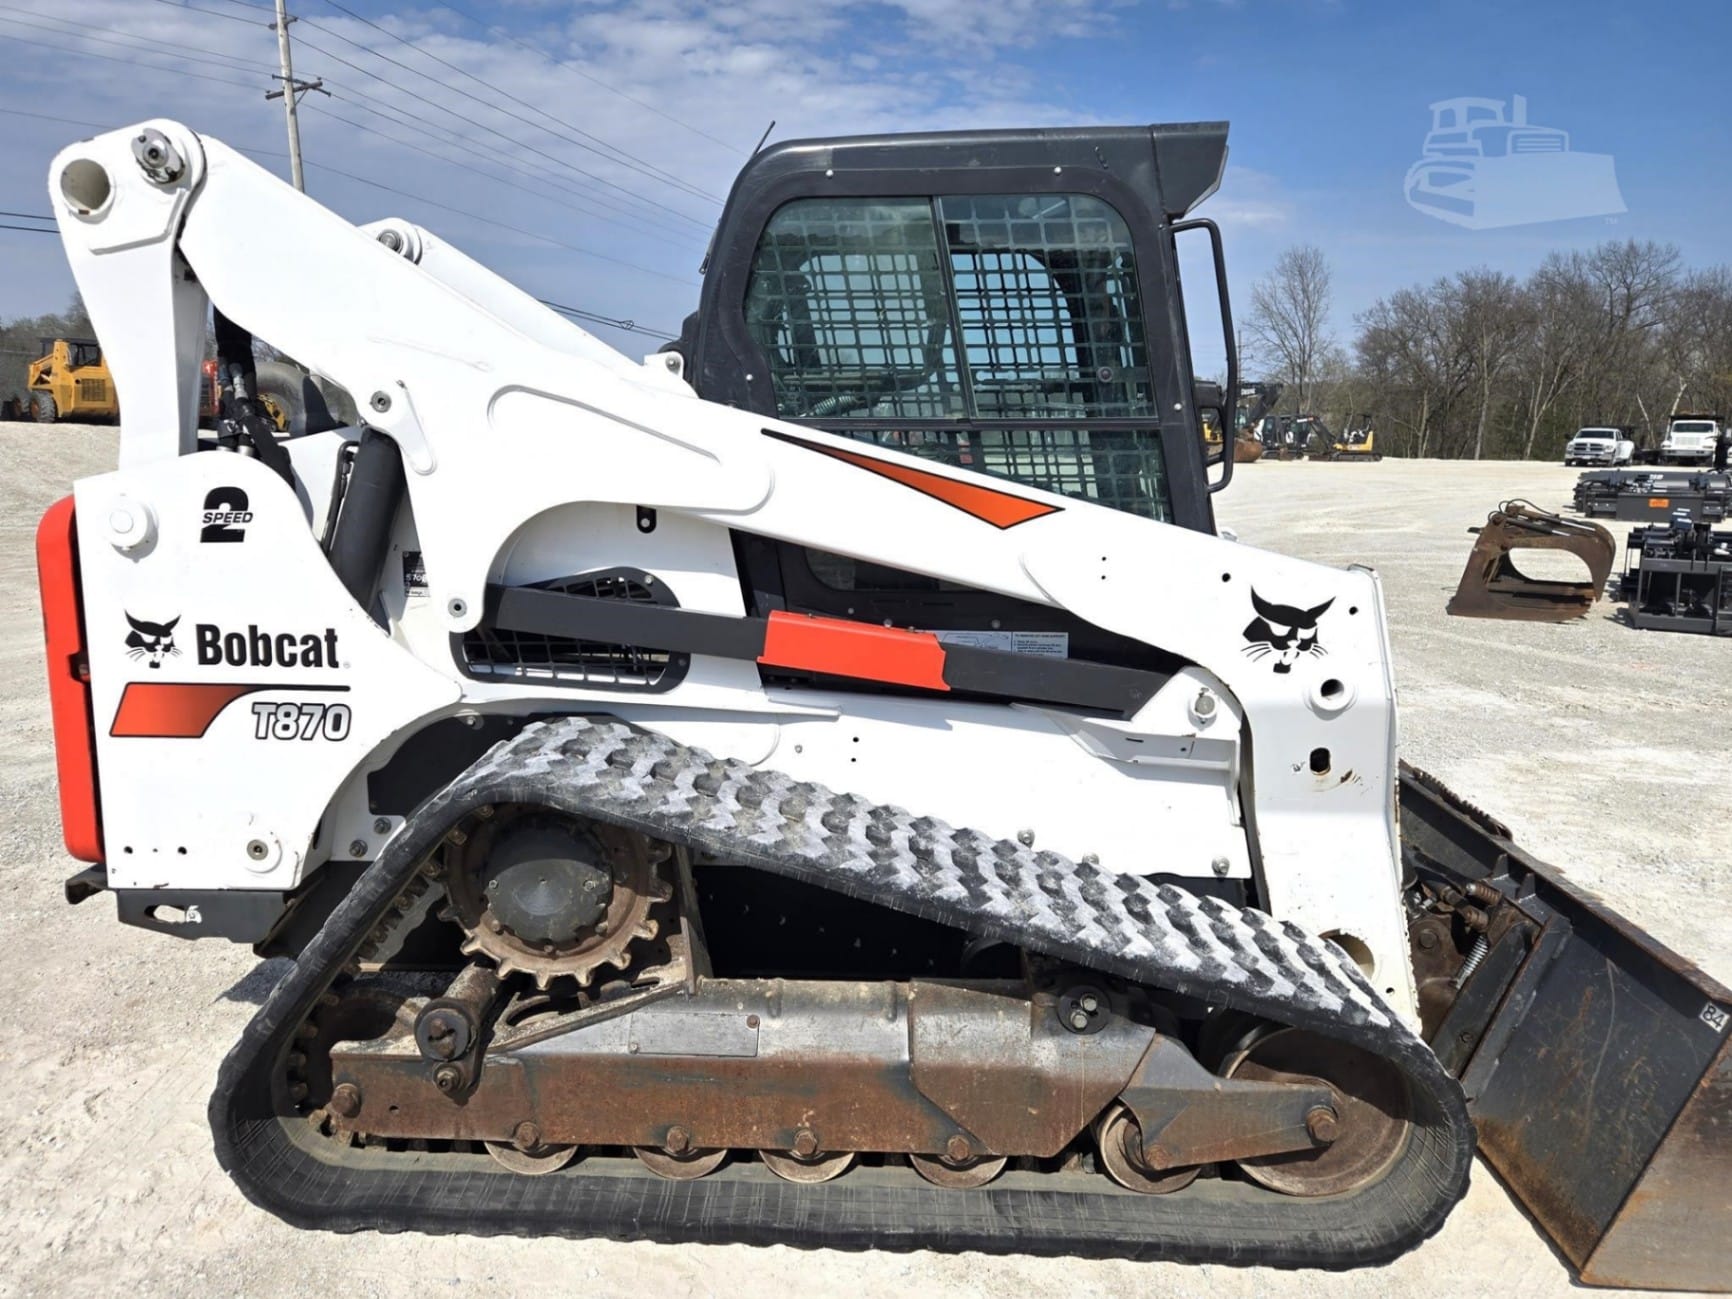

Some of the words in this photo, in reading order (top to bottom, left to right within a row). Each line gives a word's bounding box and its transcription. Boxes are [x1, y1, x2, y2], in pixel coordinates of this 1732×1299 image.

[200, 486, 249, 543] 2
[202, 511, 254, 524] SPEED
[195, 623, 340, 669] Bobcat
[251, 702, 352, 742] T870
[1703, 1005, 1724, 1028] 84
